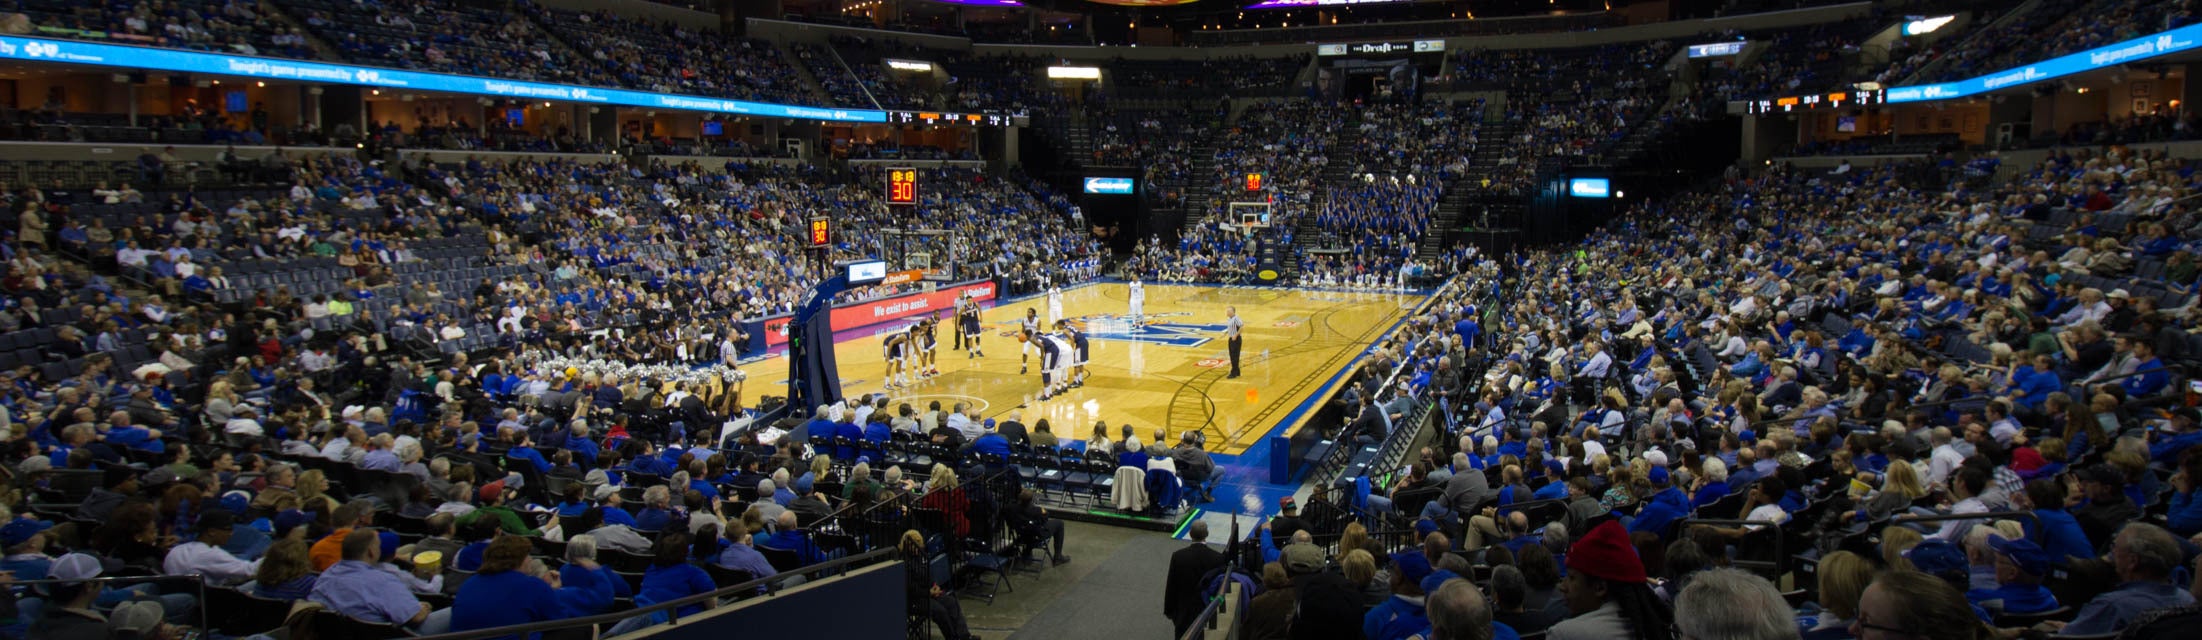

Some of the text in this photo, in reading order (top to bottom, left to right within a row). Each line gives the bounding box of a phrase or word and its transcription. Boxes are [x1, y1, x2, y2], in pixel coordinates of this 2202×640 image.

[1362, 42, 1391, 53] Draft
[228, 59, 270, 75] Tonight's
[270, 65, 297, 77] game
[893, 182, 912, 200] 30
[814, 230, 826, 243] 30
[874, 305, 885, 317] We
[885, 302, 902, 315] exist
[901, 301, 909, 312] to
